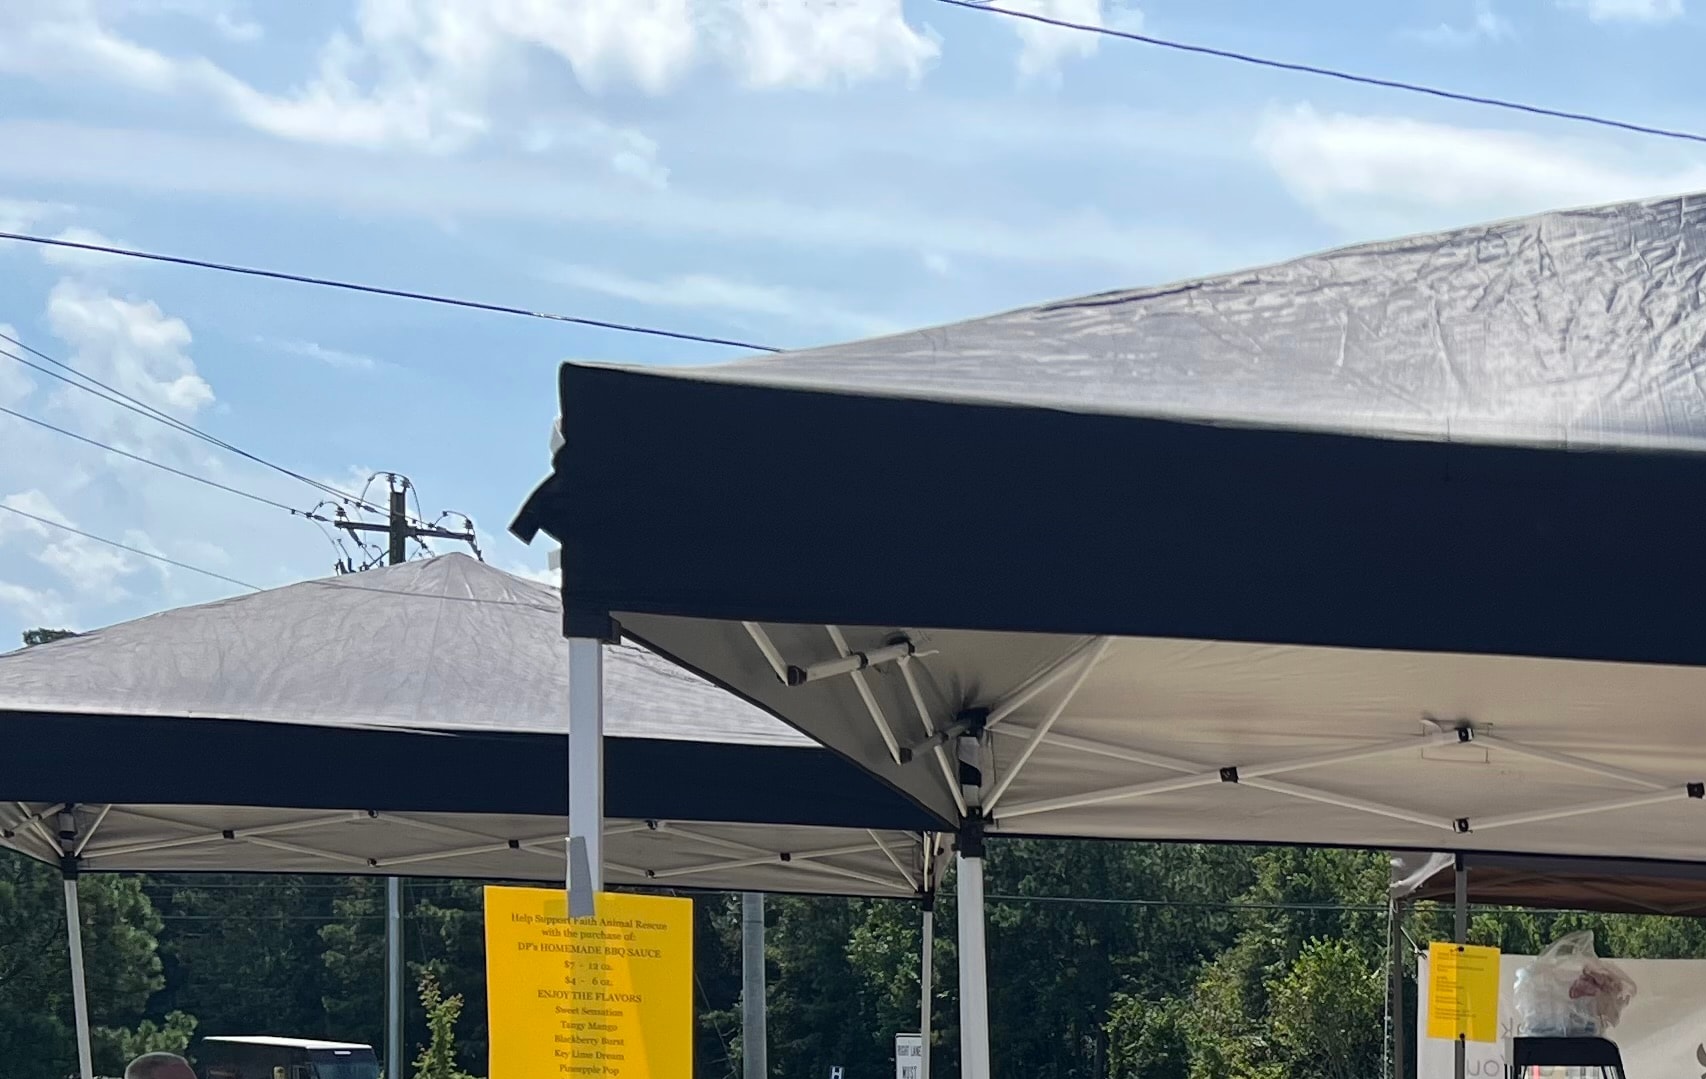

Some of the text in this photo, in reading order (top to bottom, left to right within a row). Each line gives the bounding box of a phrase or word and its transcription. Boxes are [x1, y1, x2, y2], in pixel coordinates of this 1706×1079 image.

[512, 913, 668, 930] Help Support Faith Animal Rescue
[564, 929, 578, 938] the
[581, 931, 622, 940] purchase
[518, 942, 662, 958] DP's HOMEMADE BBQ SAUCE
[564, 960, 574, 969] $7
[564, 976, 576, 986] $4
[538, 989, 642, 1003] ENJOY THE FLAVORS
[556, 1006, 580, 1014] Sweet
[560, 1021, 618, 1032] Tangy Mango
[554, 1034, 624, 1046] Blackberry Burst
[554, 1049, 624, 1060] Key Lime Dream
[603, 1066, 620, 1076] Pop
[902, 1066, 917, 1079] MUST
